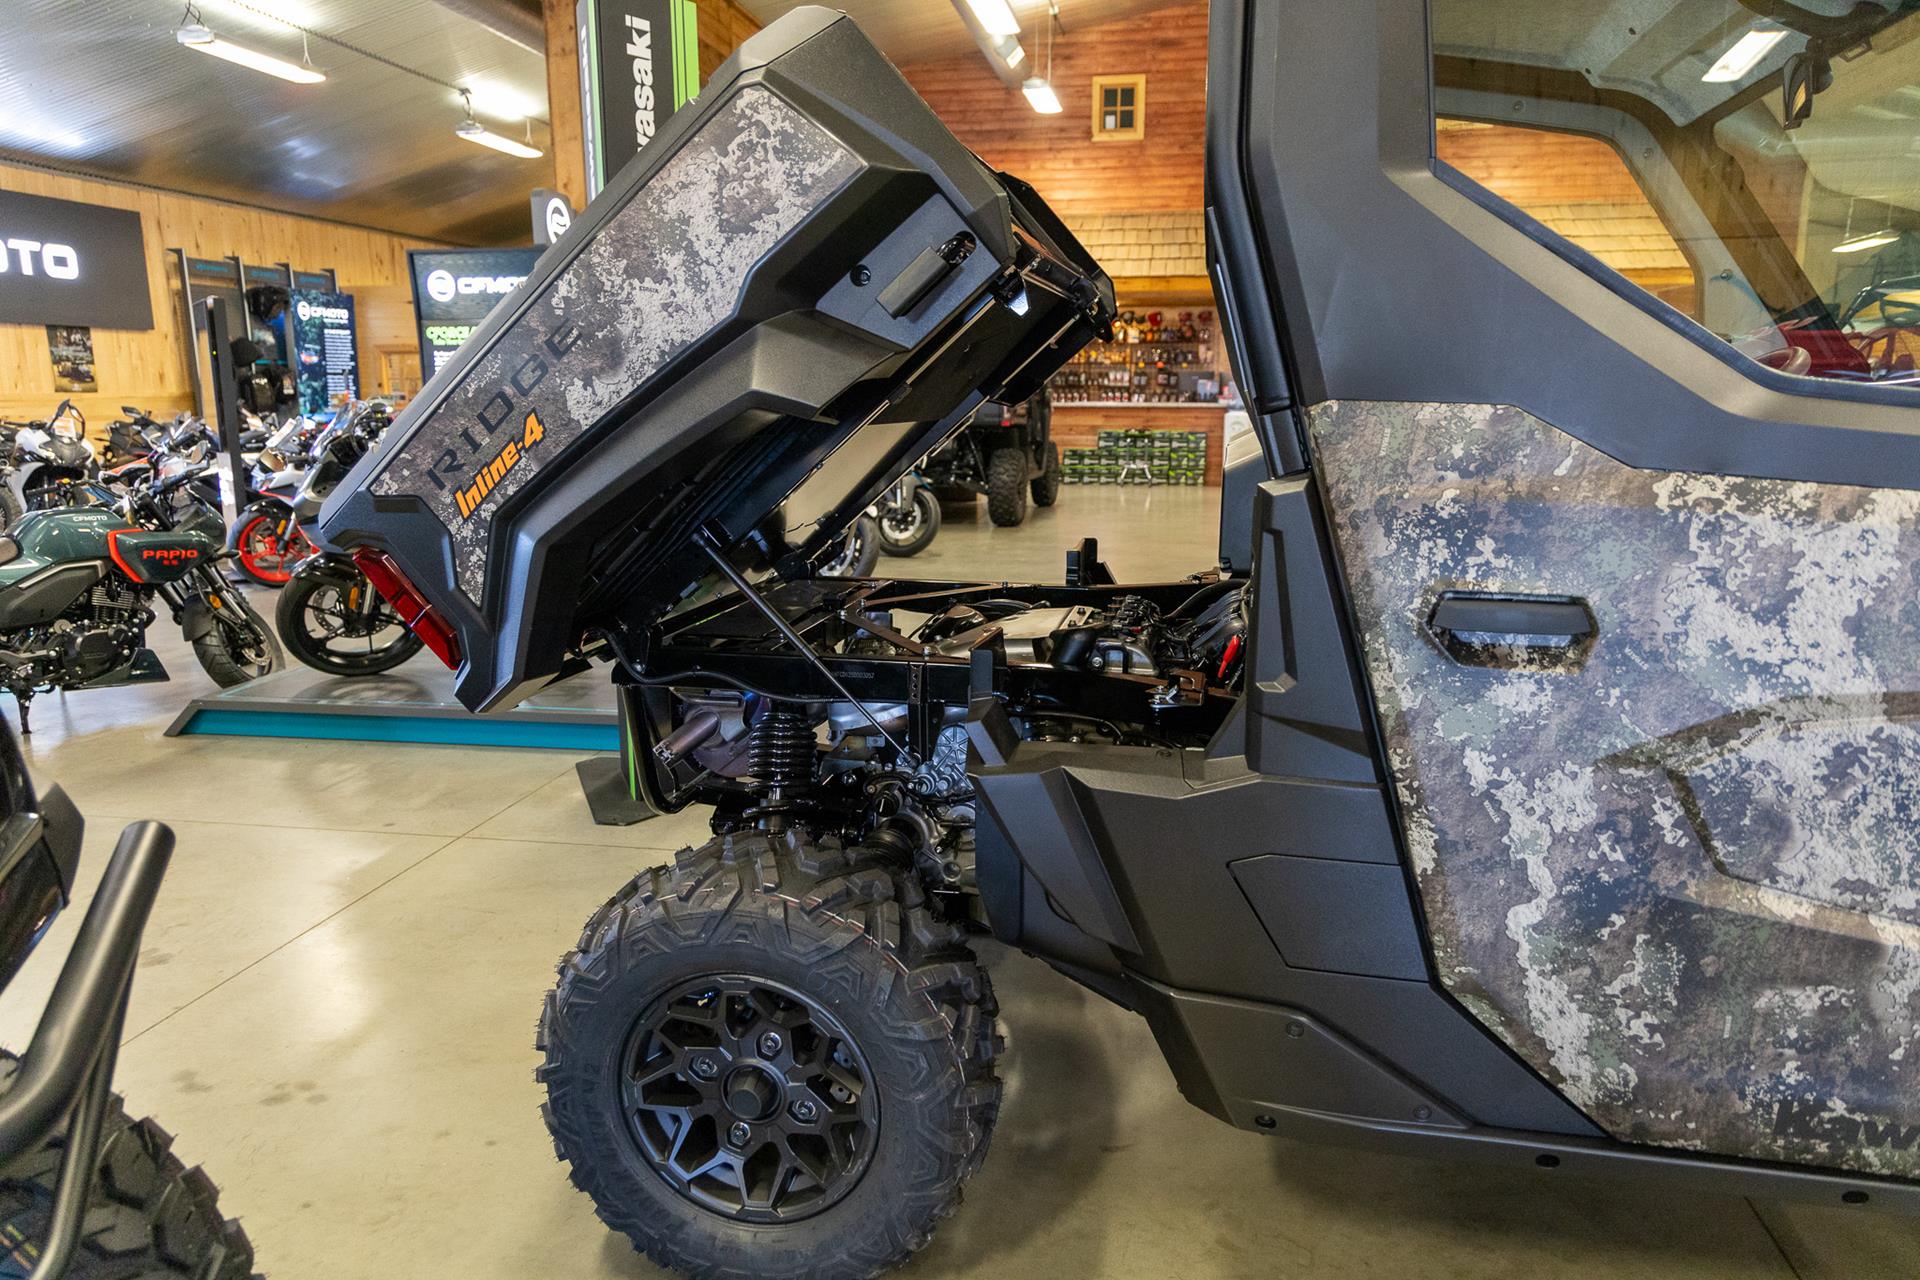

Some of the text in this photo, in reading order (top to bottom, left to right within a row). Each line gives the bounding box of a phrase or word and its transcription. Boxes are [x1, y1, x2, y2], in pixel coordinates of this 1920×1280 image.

[625, 14, 656, 153] asaki
[0, 239, 80, 281] TO
[426, 317, 583, 491] RIDGE
[142, 549, 199, 560] PAPIO
